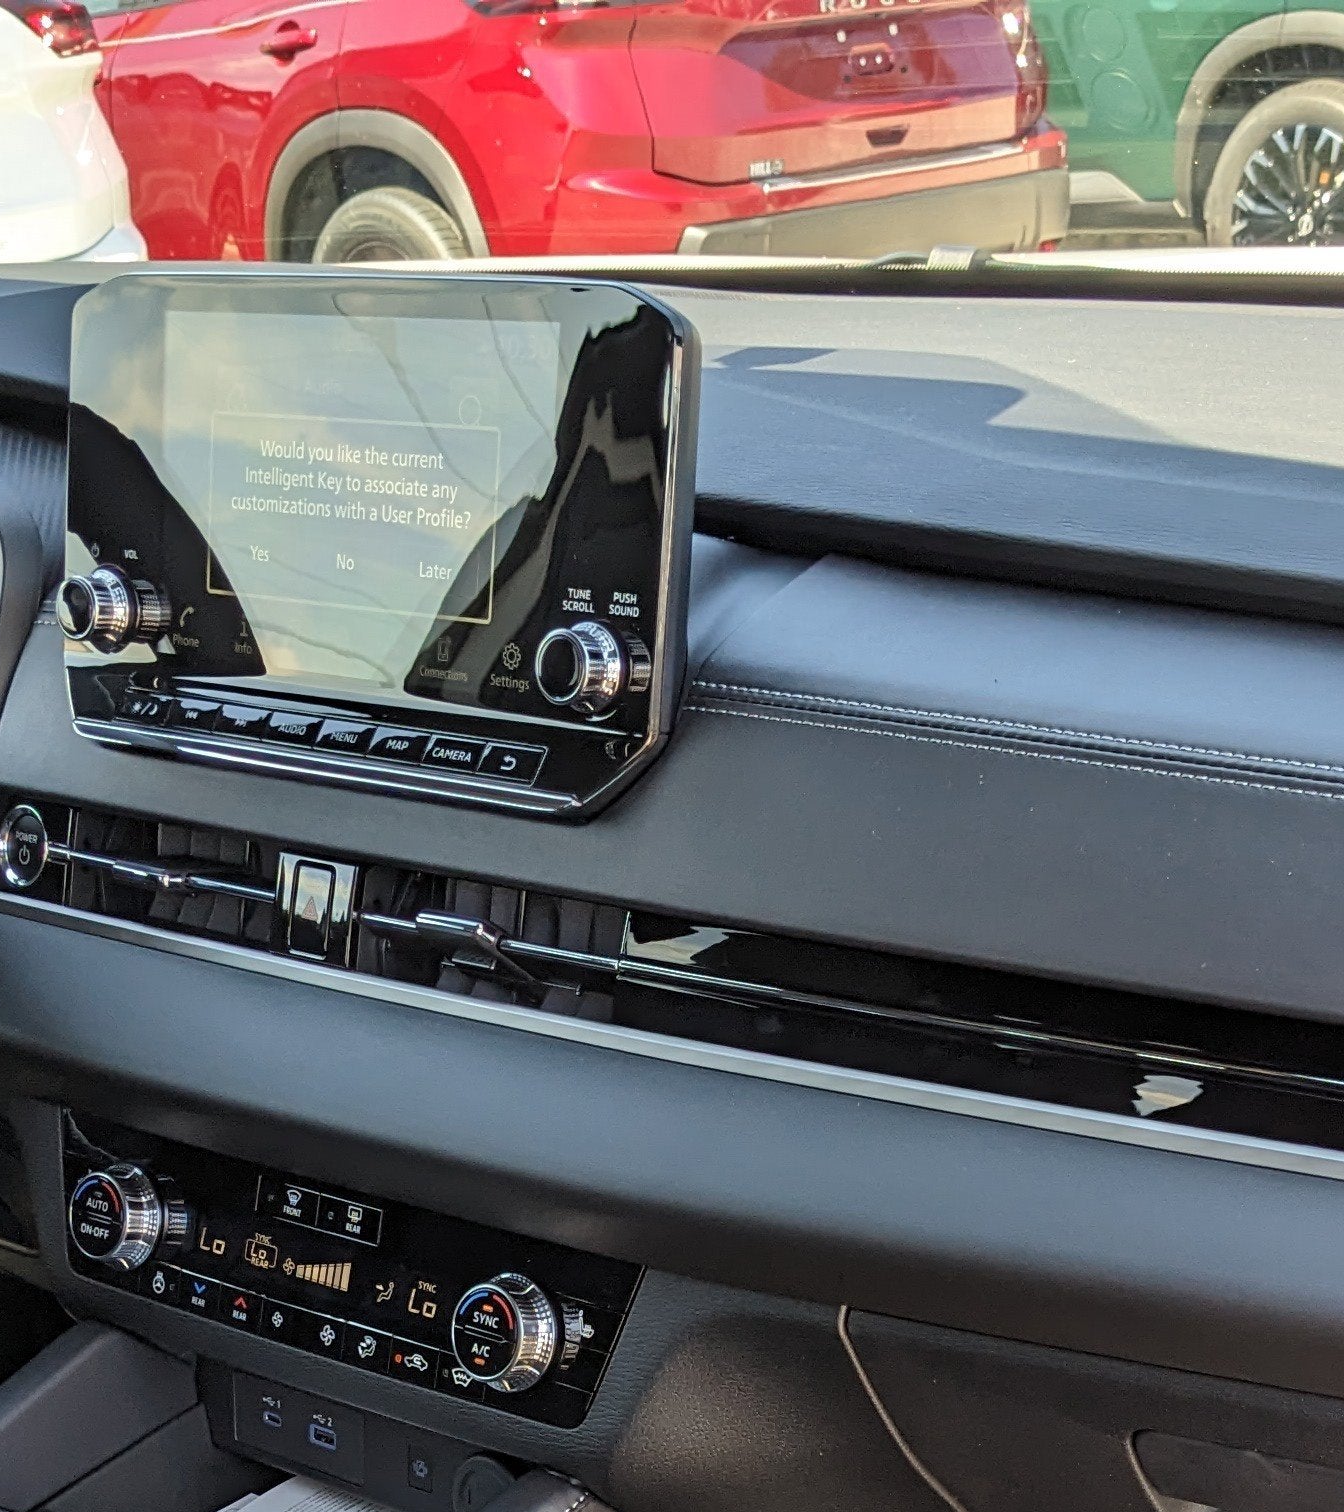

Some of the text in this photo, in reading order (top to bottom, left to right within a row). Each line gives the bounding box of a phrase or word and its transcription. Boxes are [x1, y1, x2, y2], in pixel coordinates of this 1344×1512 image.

[260, 440, 444, 469] Would you like the current
[245, 467, 457, 504] Intelligent Key to associate any
[231, 495, 471, 529] customizations with a User Profile?
[124, 549, 138, 560] VOL
[250, 545, 269, 562] Yes
[336, 553, 354, 570] No
[419, 561, 452, 580] Later
[568, 588, 592, 600] TUNE
[613, 592, 637, 604] PUSH
[563, 600, 595, 614] SCROLL
[609, 604, 640, 618] SOUND
[172, 633, 200, 648] Phone
[419, 666, 468, 682] Connections
[490, 674, 530, 693] Settings
[278, 723, 307, 736] AUDIO
[331, 731, 358, 745] MENU
[386, 739, 410, 752] MAP
[431, 747, 472, 763] CAMERA
[16, 831, 38, 844] POWER
[86, 1197, 109, 1212] AUTO
[283, 1205, 302, 1217] FRONT
[345, 1223, 361, 1234] REAR
[200, 1227, 226, 1255] Lo
[251, 1257, 269, 1269] REAR
[418, 1280, 437, 1293] SYNC
[191, 1296, 206, 1308] REAR
[408, 1288, 437, 1319] Lo
[232, 1309, 247, 1321] REAR
[473, 1311, 500, 1328] SYNC
[471, 1343, 490, 1357] A/C
